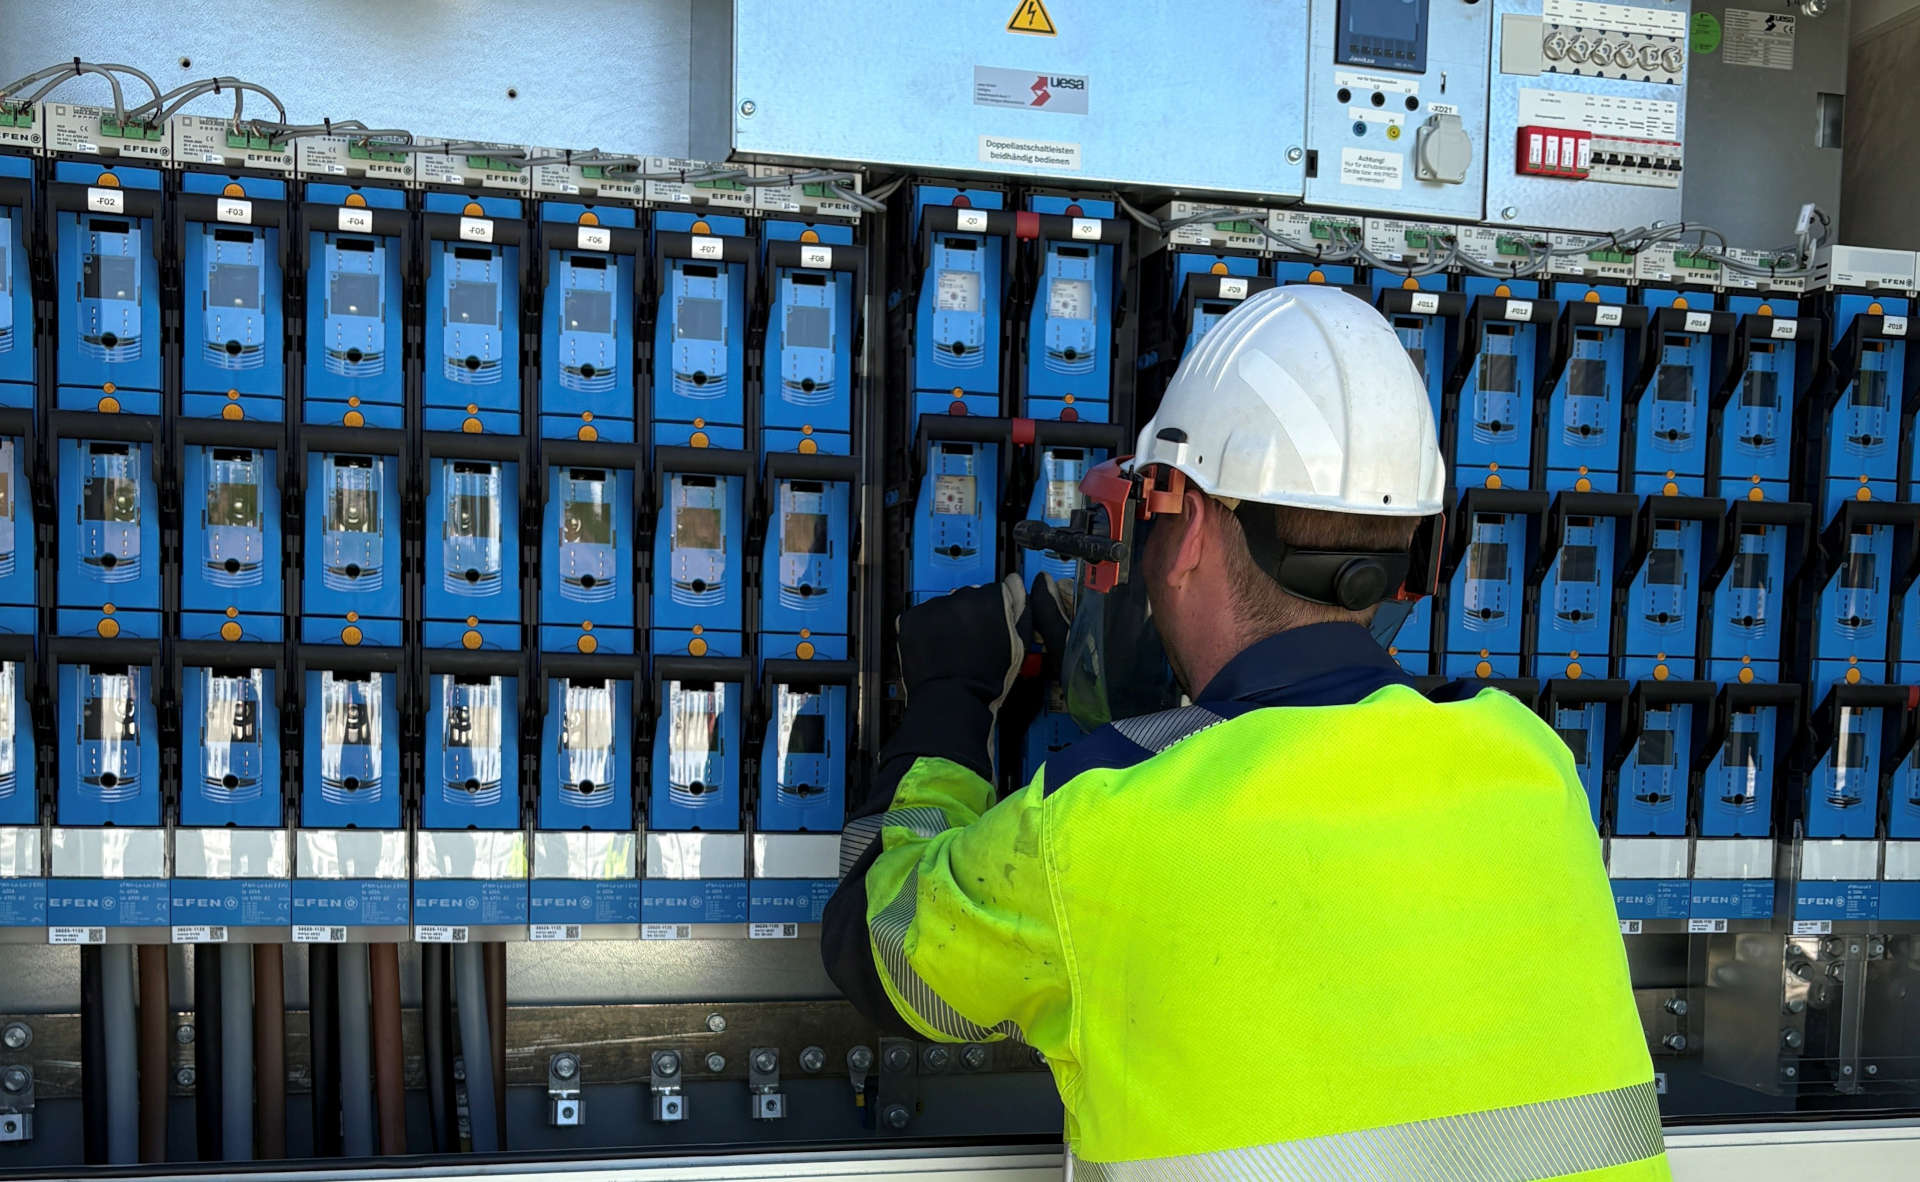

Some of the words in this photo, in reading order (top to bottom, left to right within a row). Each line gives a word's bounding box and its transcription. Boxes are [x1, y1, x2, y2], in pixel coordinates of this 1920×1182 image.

[1050, 76, 1084, 90] uesa
[123, 144, 158, 154] EFEN
[986, 139, 1074, 155] Doppellastschaltleisten
[248, 154, 282, 164] EFEN
[990, 152, 1033, 163] beidhändig
[1034, 155, 1071, 166] bedienen
[369, 164, 402, 174] EFEN
[486, 174, 518, 183] EFEN
[600, 184, 632, 192] EFEN
[96, 196, 116, 206] -F02
[712, 193, 743, 202] EFEN
[820, 202, 851, 210] EFEN
[226, 208, 244, 217] -F03
[347, 218, 364, 227] -F04
[468, 226, 486, 236] -F05
[586, 235, 603, 244] -F06
[1228, 236, 1256, 244] EFEN
[699, 246, 716, 254] -F07
[808, 254, 825, 263] -F08
[1600, 266, 1627, 276] EFEN
[1688, 272, 1714, 281] EFEN
[1772, 278, 1796, 287] EFEN
[1881, 278, 1906, 286] EFEN
[49, 897, 98, 908] EFEN
[172, 898, 222, 908] EFEN
[294, 898, 342, 908] EFEN
[416, 898, 464, 908] EFEN
[532, 898, 577, 906] EFEN
[644, 898, 688, 906] EFEN
[751, 896, 794, 906] EFEN
[1692, 896, 1729, 904] EFEN
[1798, 896, 1834, 906] EFEN
